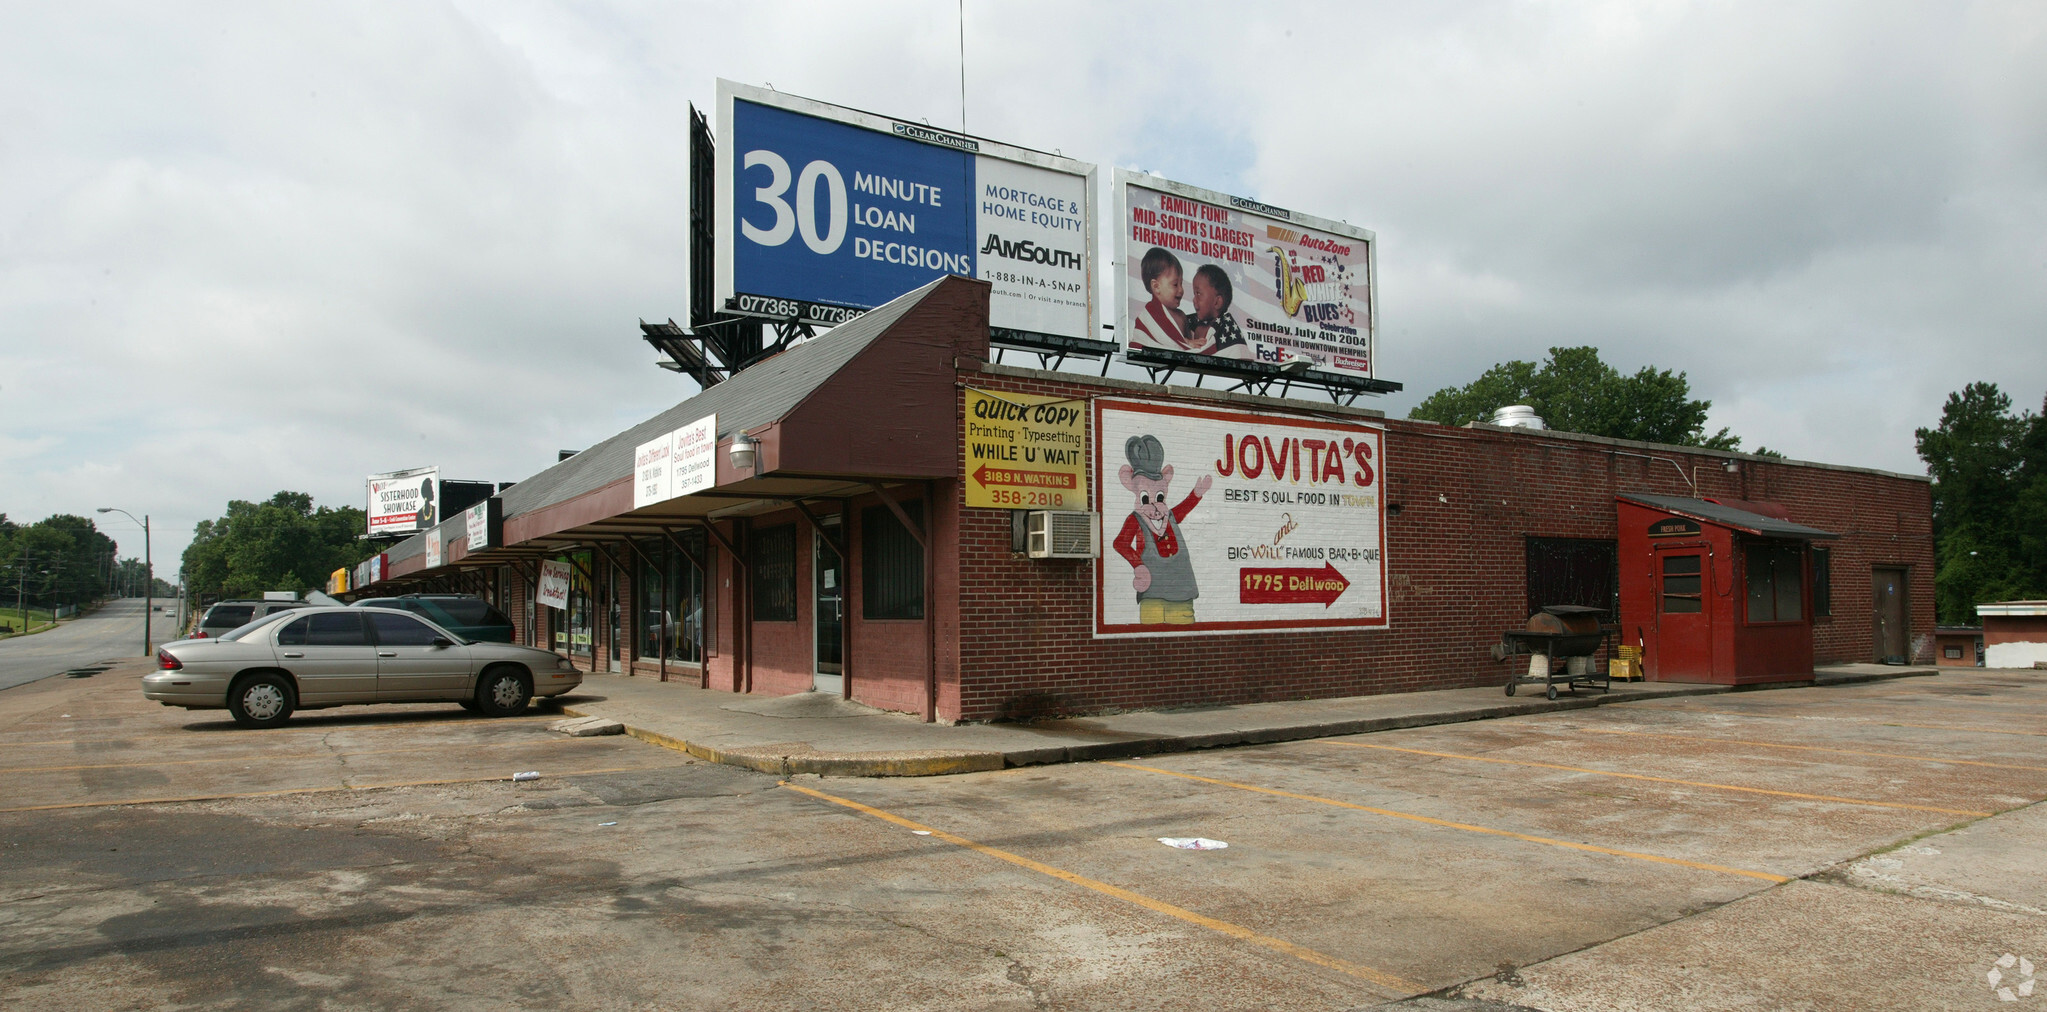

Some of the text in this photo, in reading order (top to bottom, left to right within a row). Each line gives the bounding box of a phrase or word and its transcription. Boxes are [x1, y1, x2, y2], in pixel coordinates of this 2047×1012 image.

[854, 171, 942, 207] MINUTE
[985, 184, 1078, 215] MORTGAGE &
[741, 149, 848, 255] 30
[1160, 195, 1228, 225] FAMILY FUN!!
[855, 203, 915, 234] LOAN
[983, 201, 1081, 232] HOME EQUITY
[1133, 207, 1254, 248] MID-SOUTH'S LARGEST
[855, 237, 971, 275] DECISIONS
[1133, 225, 1255, 266] FIREWORKS DISPLAY!!!
[1299, 233, 1351, 257] AutoZone
[985, 270, 1081, 293] 1-888-IN-A-SNAP
[1302, 265, 1325, 284] RED
[739, 294, 799, 317] 077365
[1038, 295, 1051, 303] visit
[1053, 298, 1064, 306] any
[1065, 300, 1087, 308] branch
[1303, 302, 1339, 323] BLUES
[1246, 318, 1366, 347] Sunday, July 4th 2004
[1319, 321, 1358, 335] Celebration
[1247, 331, 1367, 358] TOM LEE PARK IN DOWNTOWN MEMPHIS
[1335, 357, 1366, 368] Budweiser
[974, 398, 1080, 427] QUICK COPY
[695, 426, 706, 443] Best
[969, 422, 1081, 447] Printing Typesetting
[674, 449, 685, 463] Soul
[685, 445, 695, 459] food
[701, 441, 714, 453] town
[972, 442, 1018, 461] WHILE
[1043, 448, 1079, 465] WAIT
[1215, 433, 1375, 488] JOVITA'S
[676, 457, 710, 477] 1795 Dellwood
[984, 471, 1011, 483] 3189
[1023, 474, 1070, 486] WATKINS
[380, 487, 419, 502] SISTERHOOD
[991, 489, 1064, 507] 358-2818
[1225, 489, 1375, 507] BEST SOUL FOOD IN TOWN
[383, 501, 417, 514] SHOWCASE
[1274, 512, 1298, 545] and
[1227, 547, 1248, 560] BIG
[1285, 547, 1324, 560] FAMOUS
[1244, 574, 1283, 591] 1795
